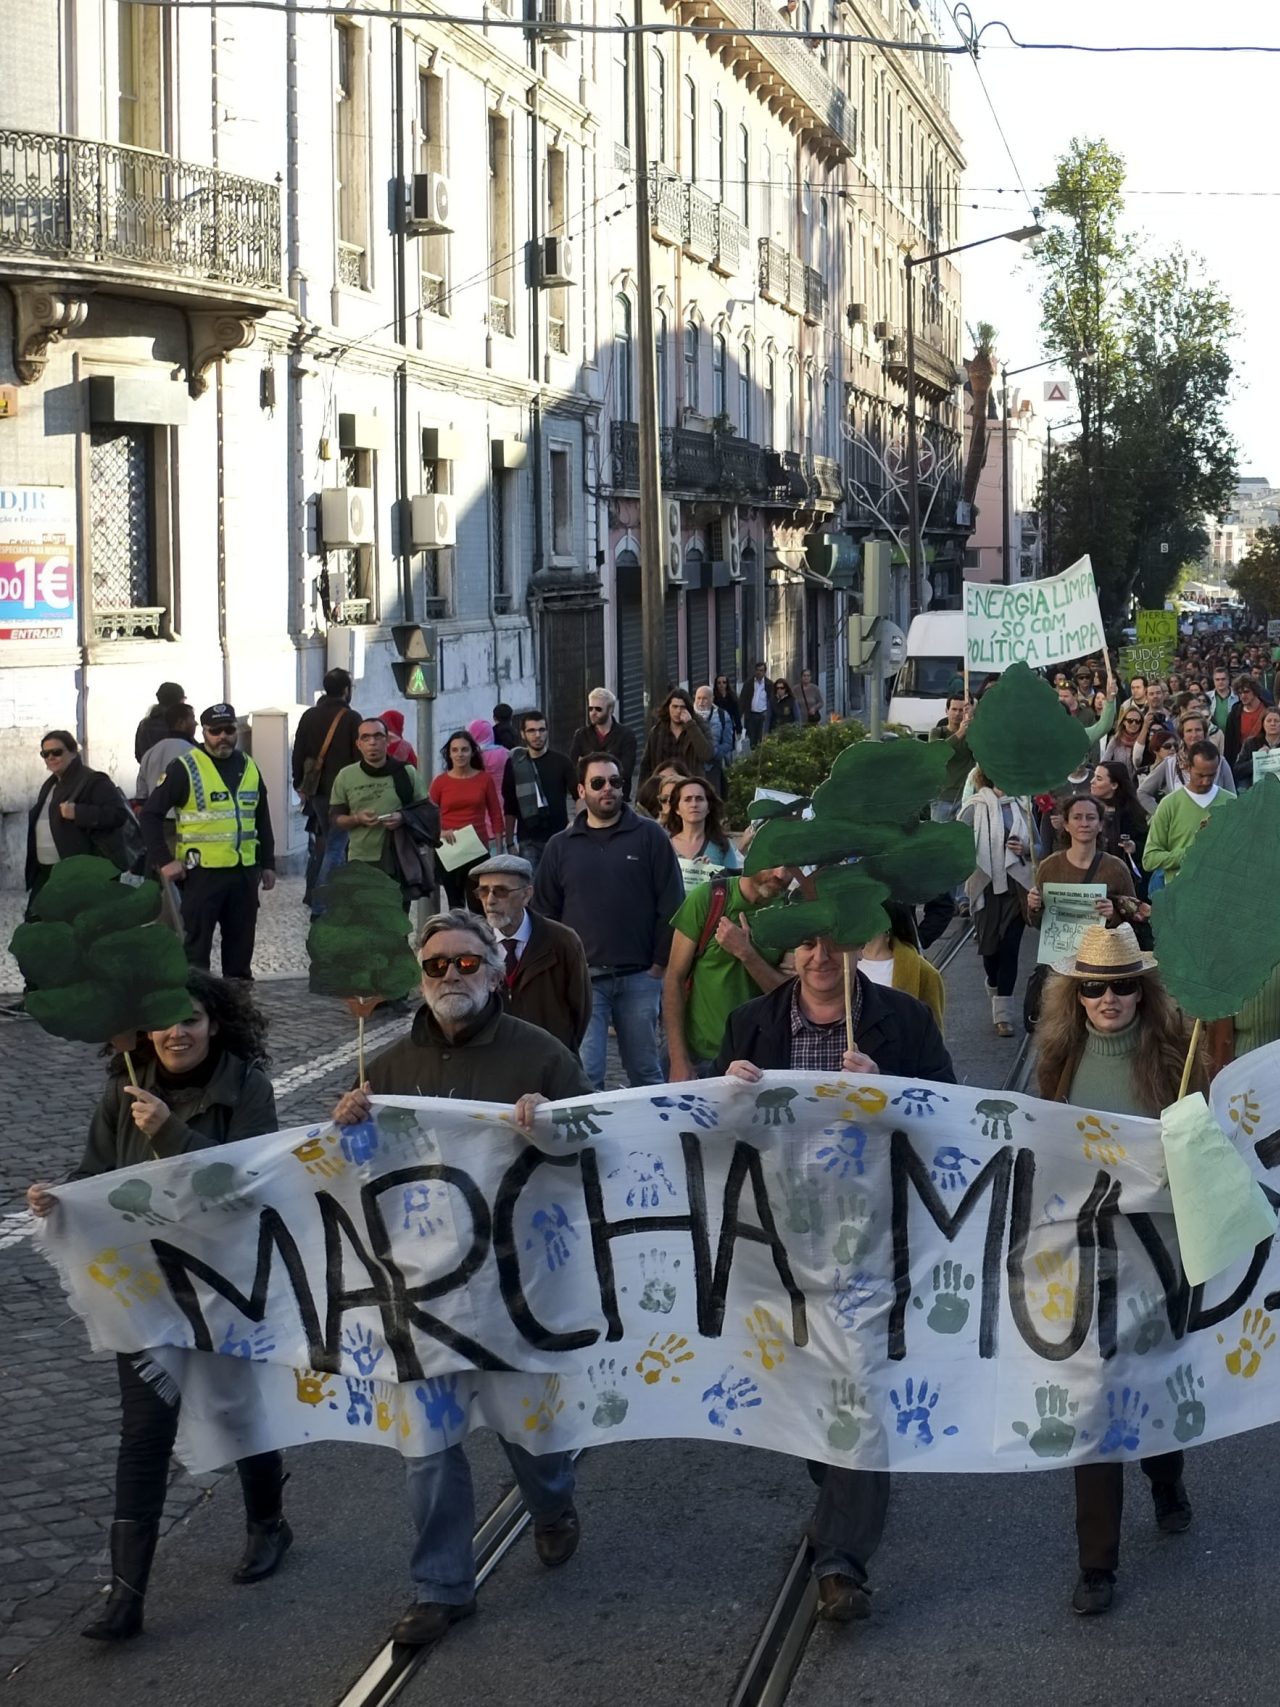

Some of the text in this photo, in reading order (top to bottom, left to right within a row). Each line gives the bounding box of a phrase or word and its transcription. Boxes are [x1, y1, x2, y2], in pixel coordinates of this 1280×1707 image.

[1001, 613, 1066, 638] SÓ COM
[1145, 621, 1170, 636] NO
[10, 627, 63, 640] ENTRADA
[1046, 622, 1102, 659] LIMPA
[1126, 646, 1165, 661] JUDGE
[1135, 660, 1159, 672] ECO
[150, 1131, 807, 1381] MARCHA
